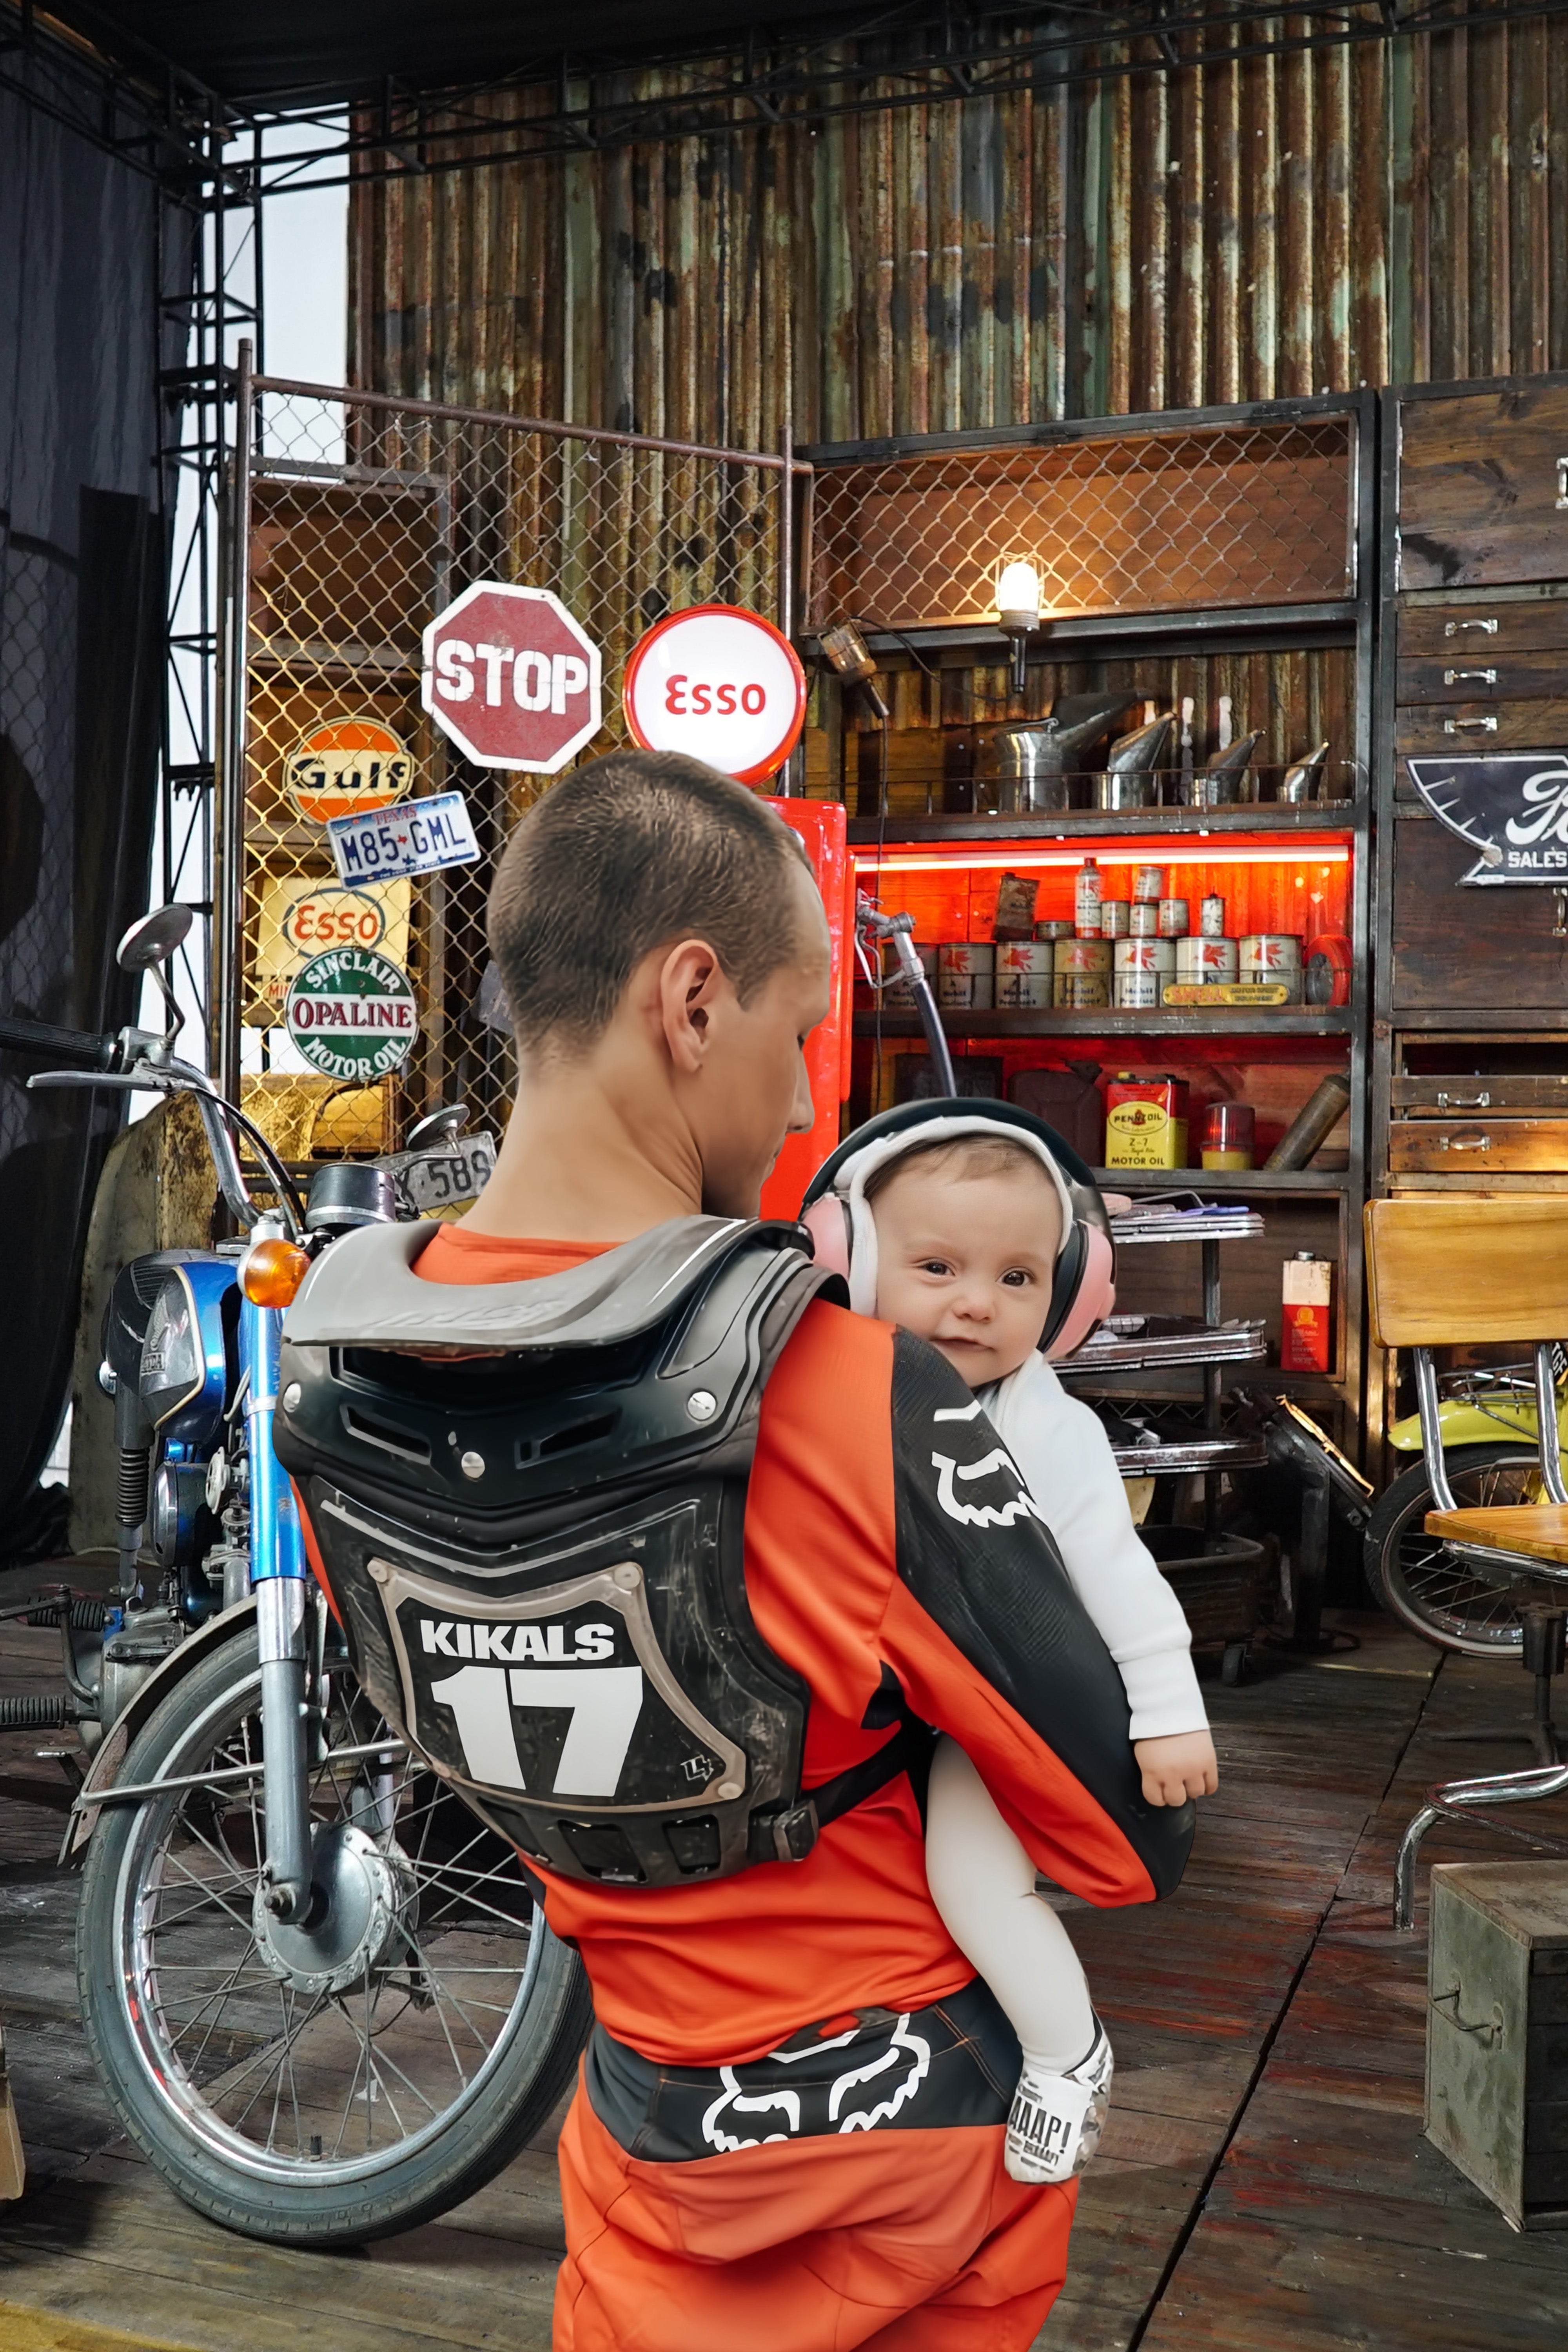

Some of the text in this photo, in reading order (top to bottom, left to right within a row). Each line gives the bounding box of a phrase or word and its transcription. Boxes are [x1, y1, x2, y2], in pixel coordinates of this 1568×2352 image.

[436, 639, 588, 714] STOP
[291, 759, 407, 789] Gulf
[373, 806, 417, 826] TEXAS
[341, 813, 466, 871] M85 GML
[1508, 851, 1567, 868] SALES
[305, 952, 401, 994] SINCLAIR
[292, 997, 412, 1029] OPALINE
[303, 1037, 406, 1077] MOTOR OIL
[1111, 1157, 1146, 1165] MOTOR
[420, 1619, 614, 1661] KIKALS
[430, 1666, 643, 1797] 17
